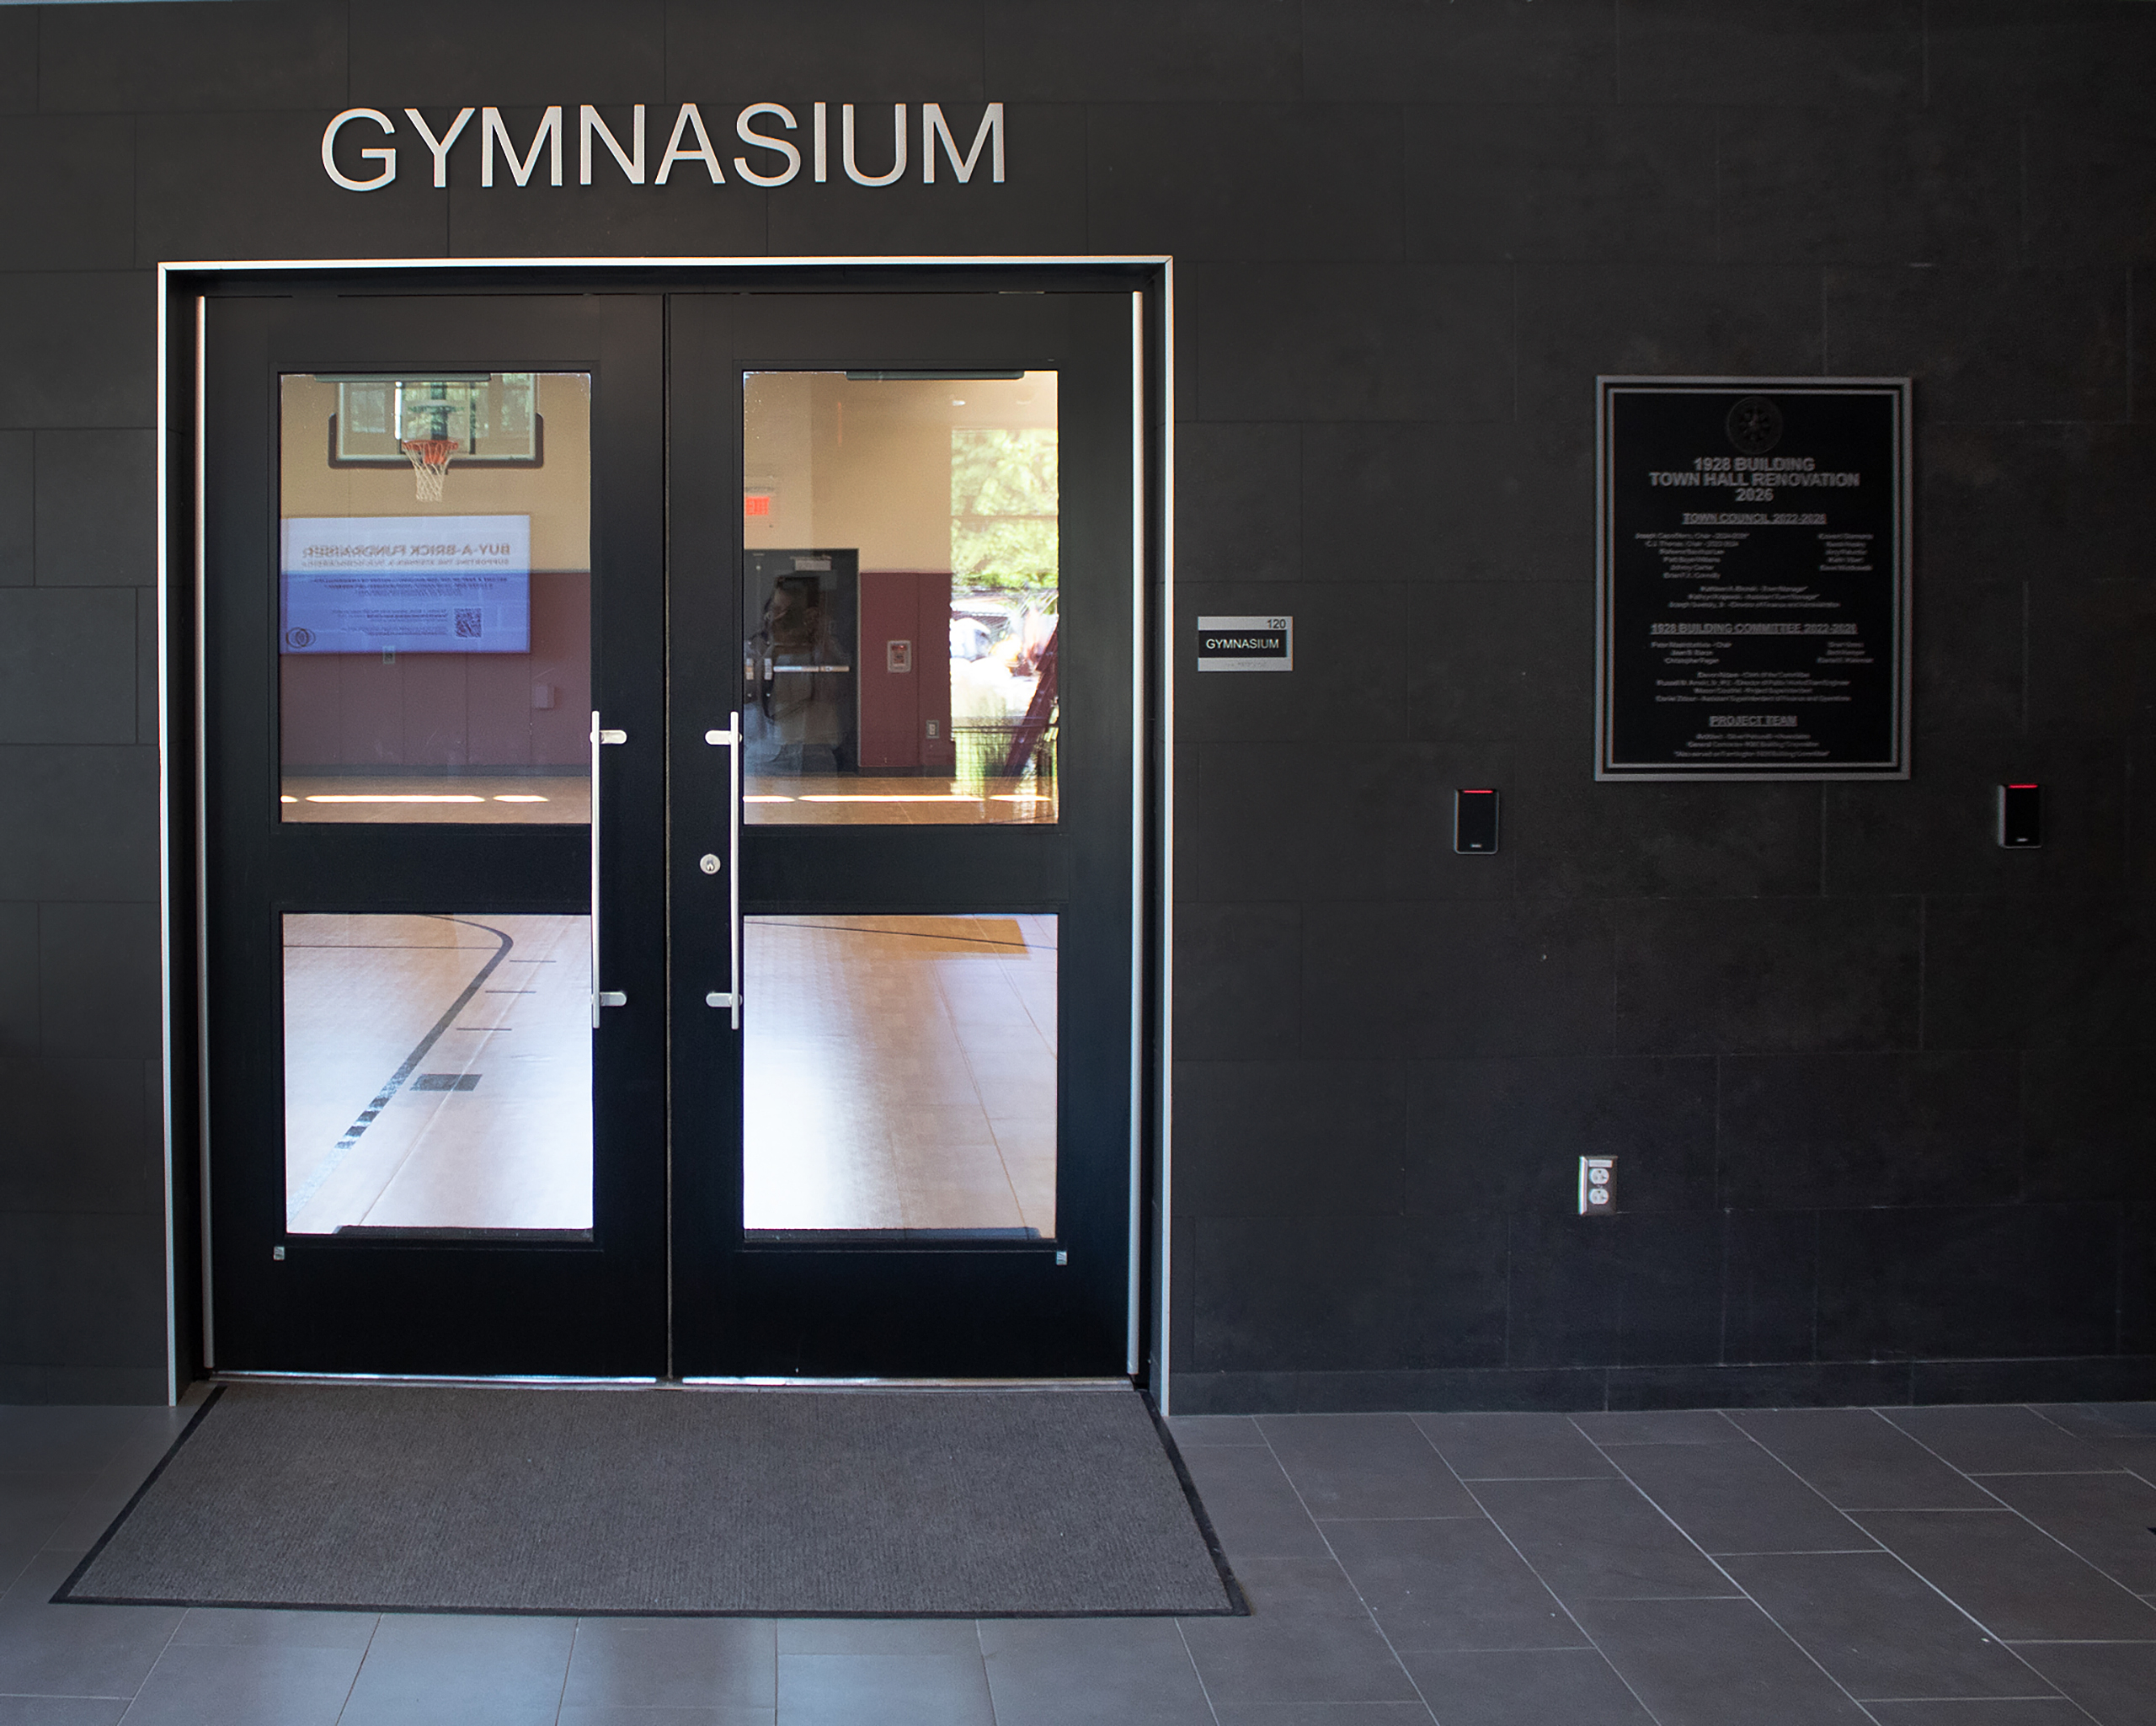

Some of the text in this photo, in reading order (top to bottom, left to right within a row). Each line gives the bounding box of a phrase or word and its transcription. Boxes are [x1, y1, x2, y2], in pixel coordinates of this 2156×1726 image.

[321, 101, 1006, 192] GYMNASIUM
[1694, 457, 1816, 472] 1928 BUILDING
[1649, 472, 1860, 487] TOWN HALL RENOVATION
[1683, 513, 1718, 525] TOWN
[1719, 513, 1771, 525] COUNCIL
[1266, 618, 1287, 629] 120
[1679, 623, 1735, 635] BUILDING
[1737, 623, 1803, 635] COMMITTEE
[1205, 638, 1279, 649] GYMNASIUM
[1709, 715, 1798, 727] PROJECT TEAM
